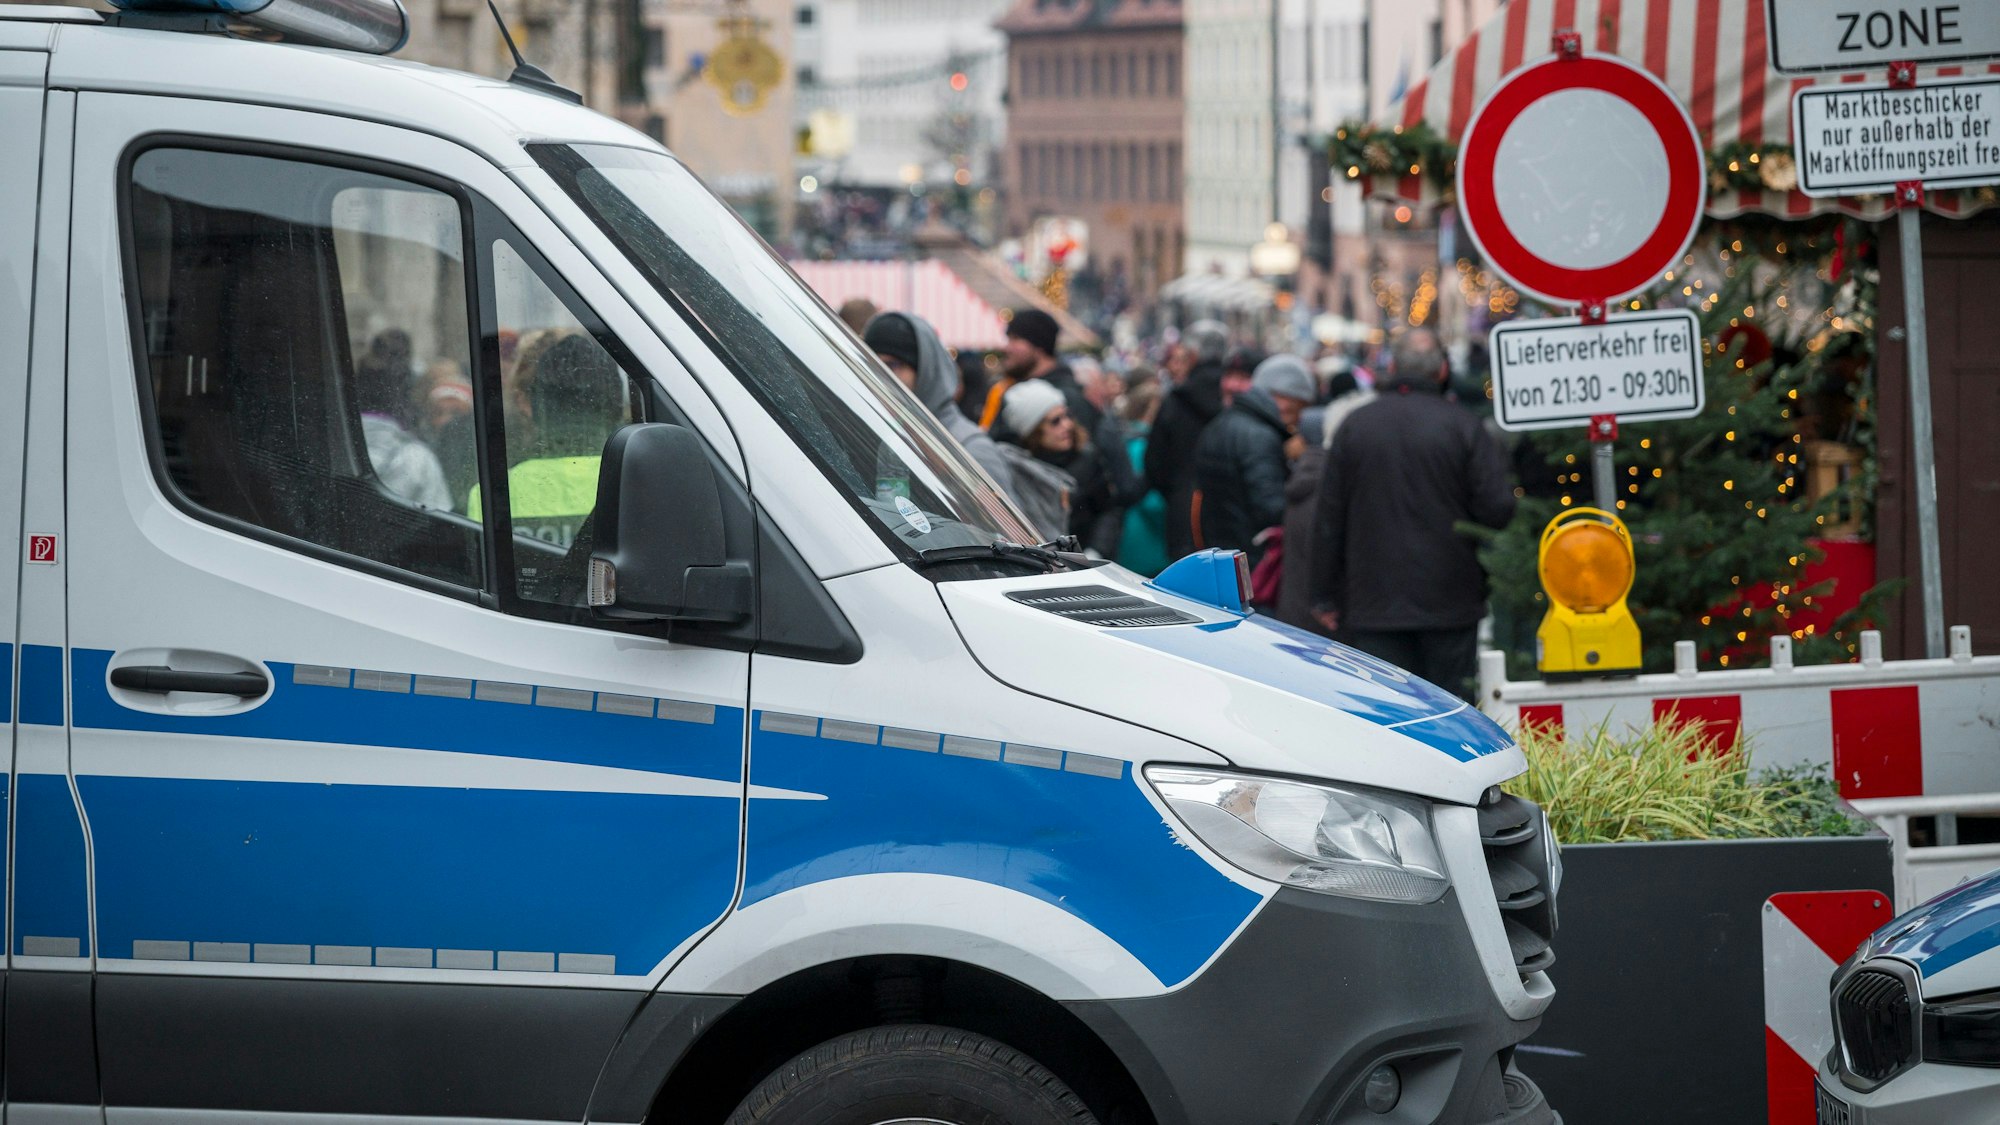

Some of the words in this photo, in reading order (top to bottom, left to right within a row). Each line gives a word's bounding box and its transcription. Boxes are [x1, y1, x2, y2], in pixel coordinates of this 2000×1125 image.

[1836, 6, 1962, 51] ZONE
[1825, 87, 1982, 120] Marktbeschicker
[1822, 126, 1852, 146] nur
[1861, 117, 1953, 144] außerhalb
[1962, 114, 1991, 138] der
[1810, 142, 1968, 174] Marktöffnungszeit
[1504, 330, 1647, 366] Lieferverkehr
[1654, 326, 1688, 355] frei
[1507, 386, 1544, 408] von
[1551, 375, 1600, 405] 21:30
[1623, 368, 1690, 399] 09:30h
